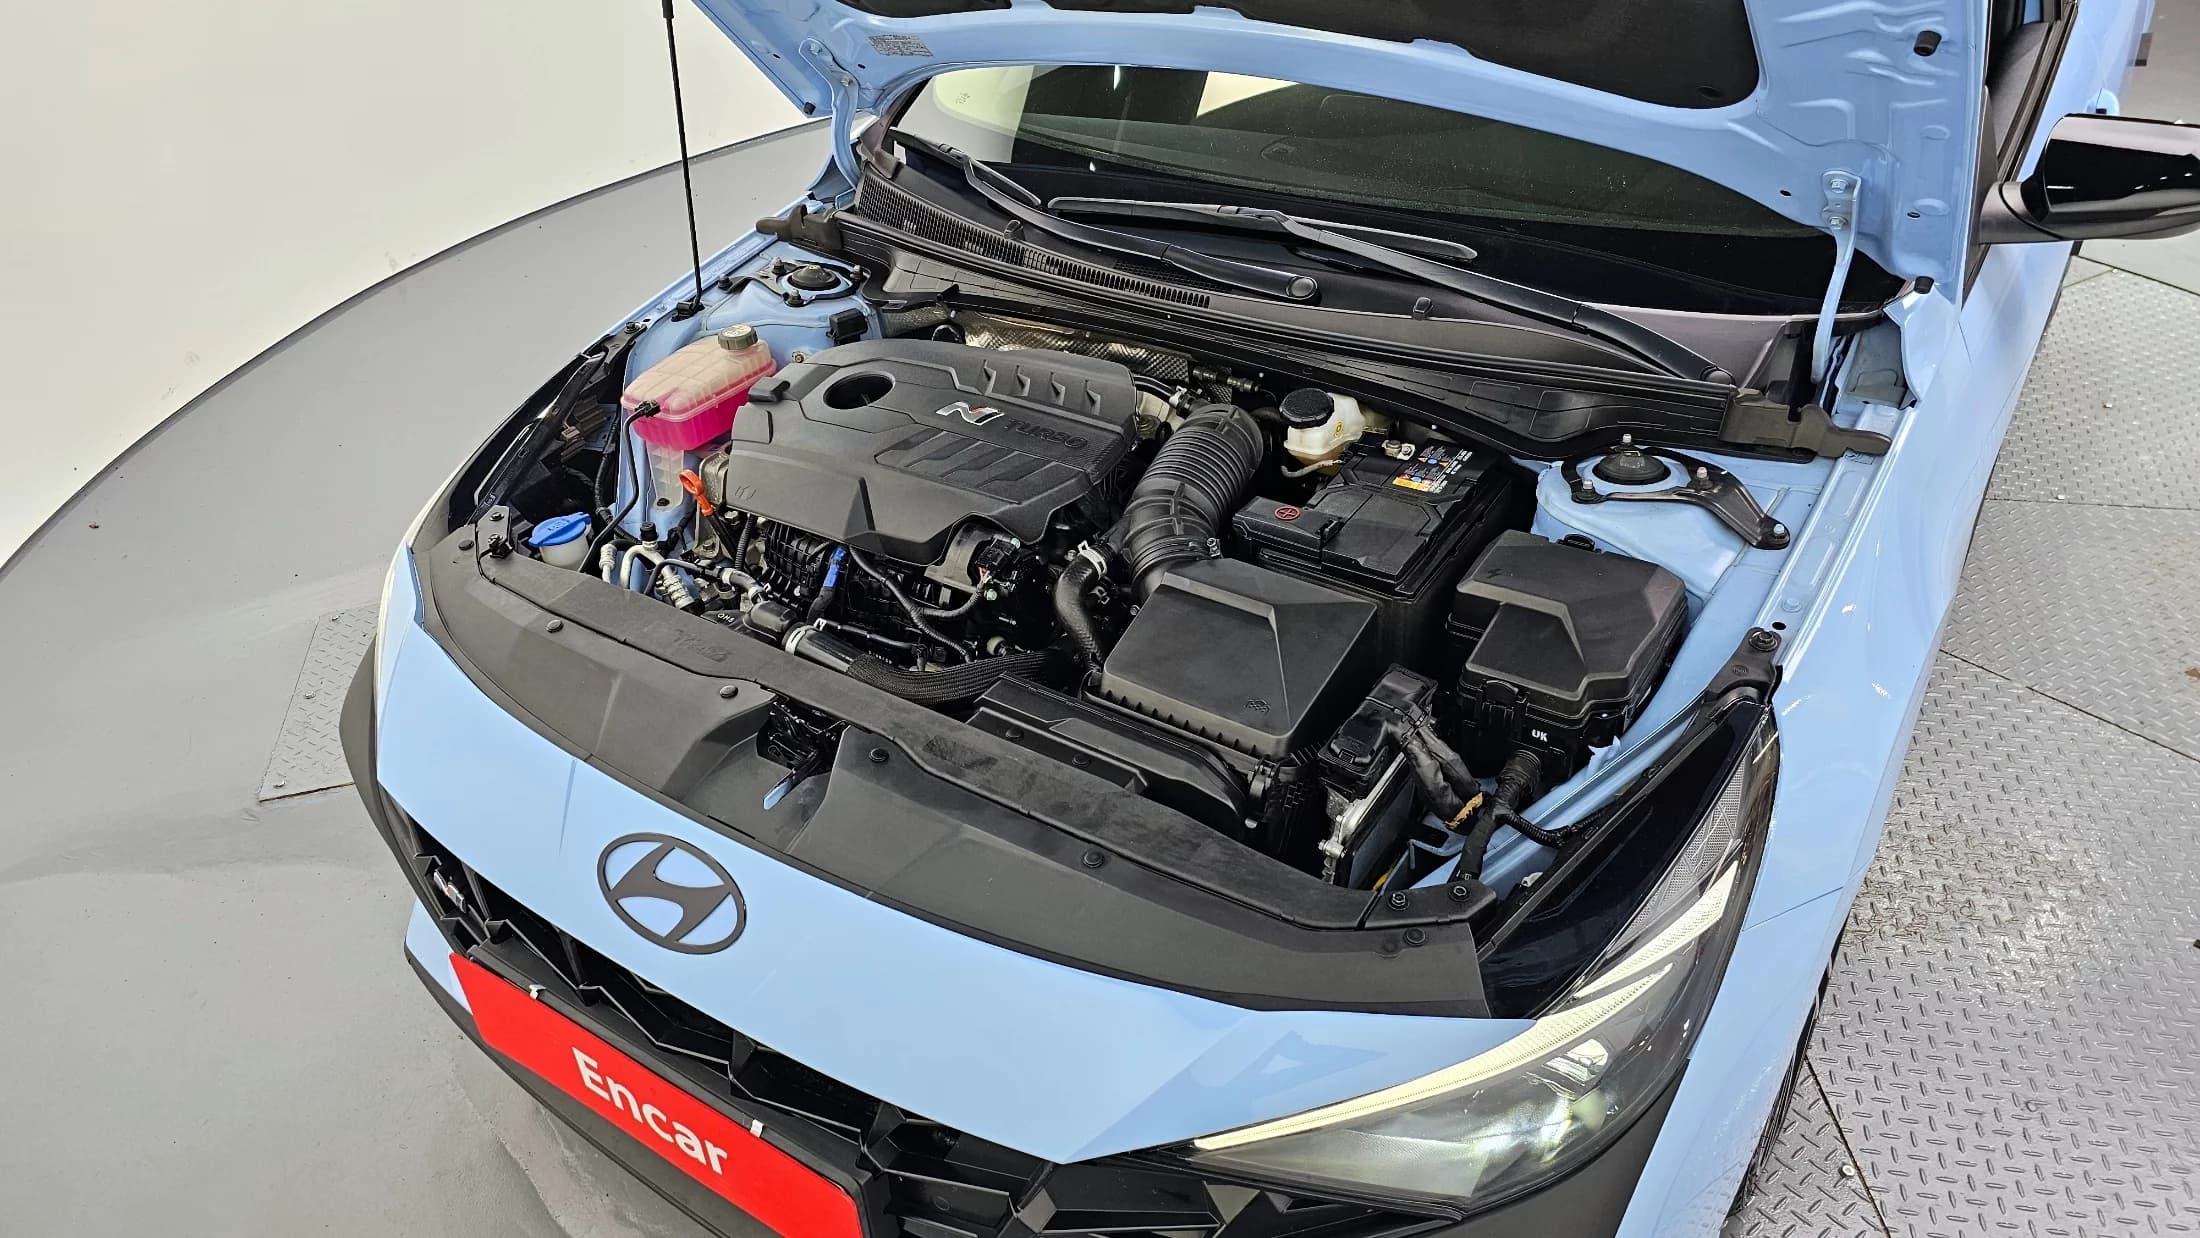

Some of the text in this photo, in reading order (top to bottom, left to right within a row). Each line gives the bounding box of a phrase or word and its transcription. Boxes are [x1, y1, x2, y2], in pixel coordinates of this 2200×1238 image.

[1003, 416, 1089, 449] TURBO
[1531, 728, 1549, 742] UK
[571, 1046, 728, 1176] Encar
